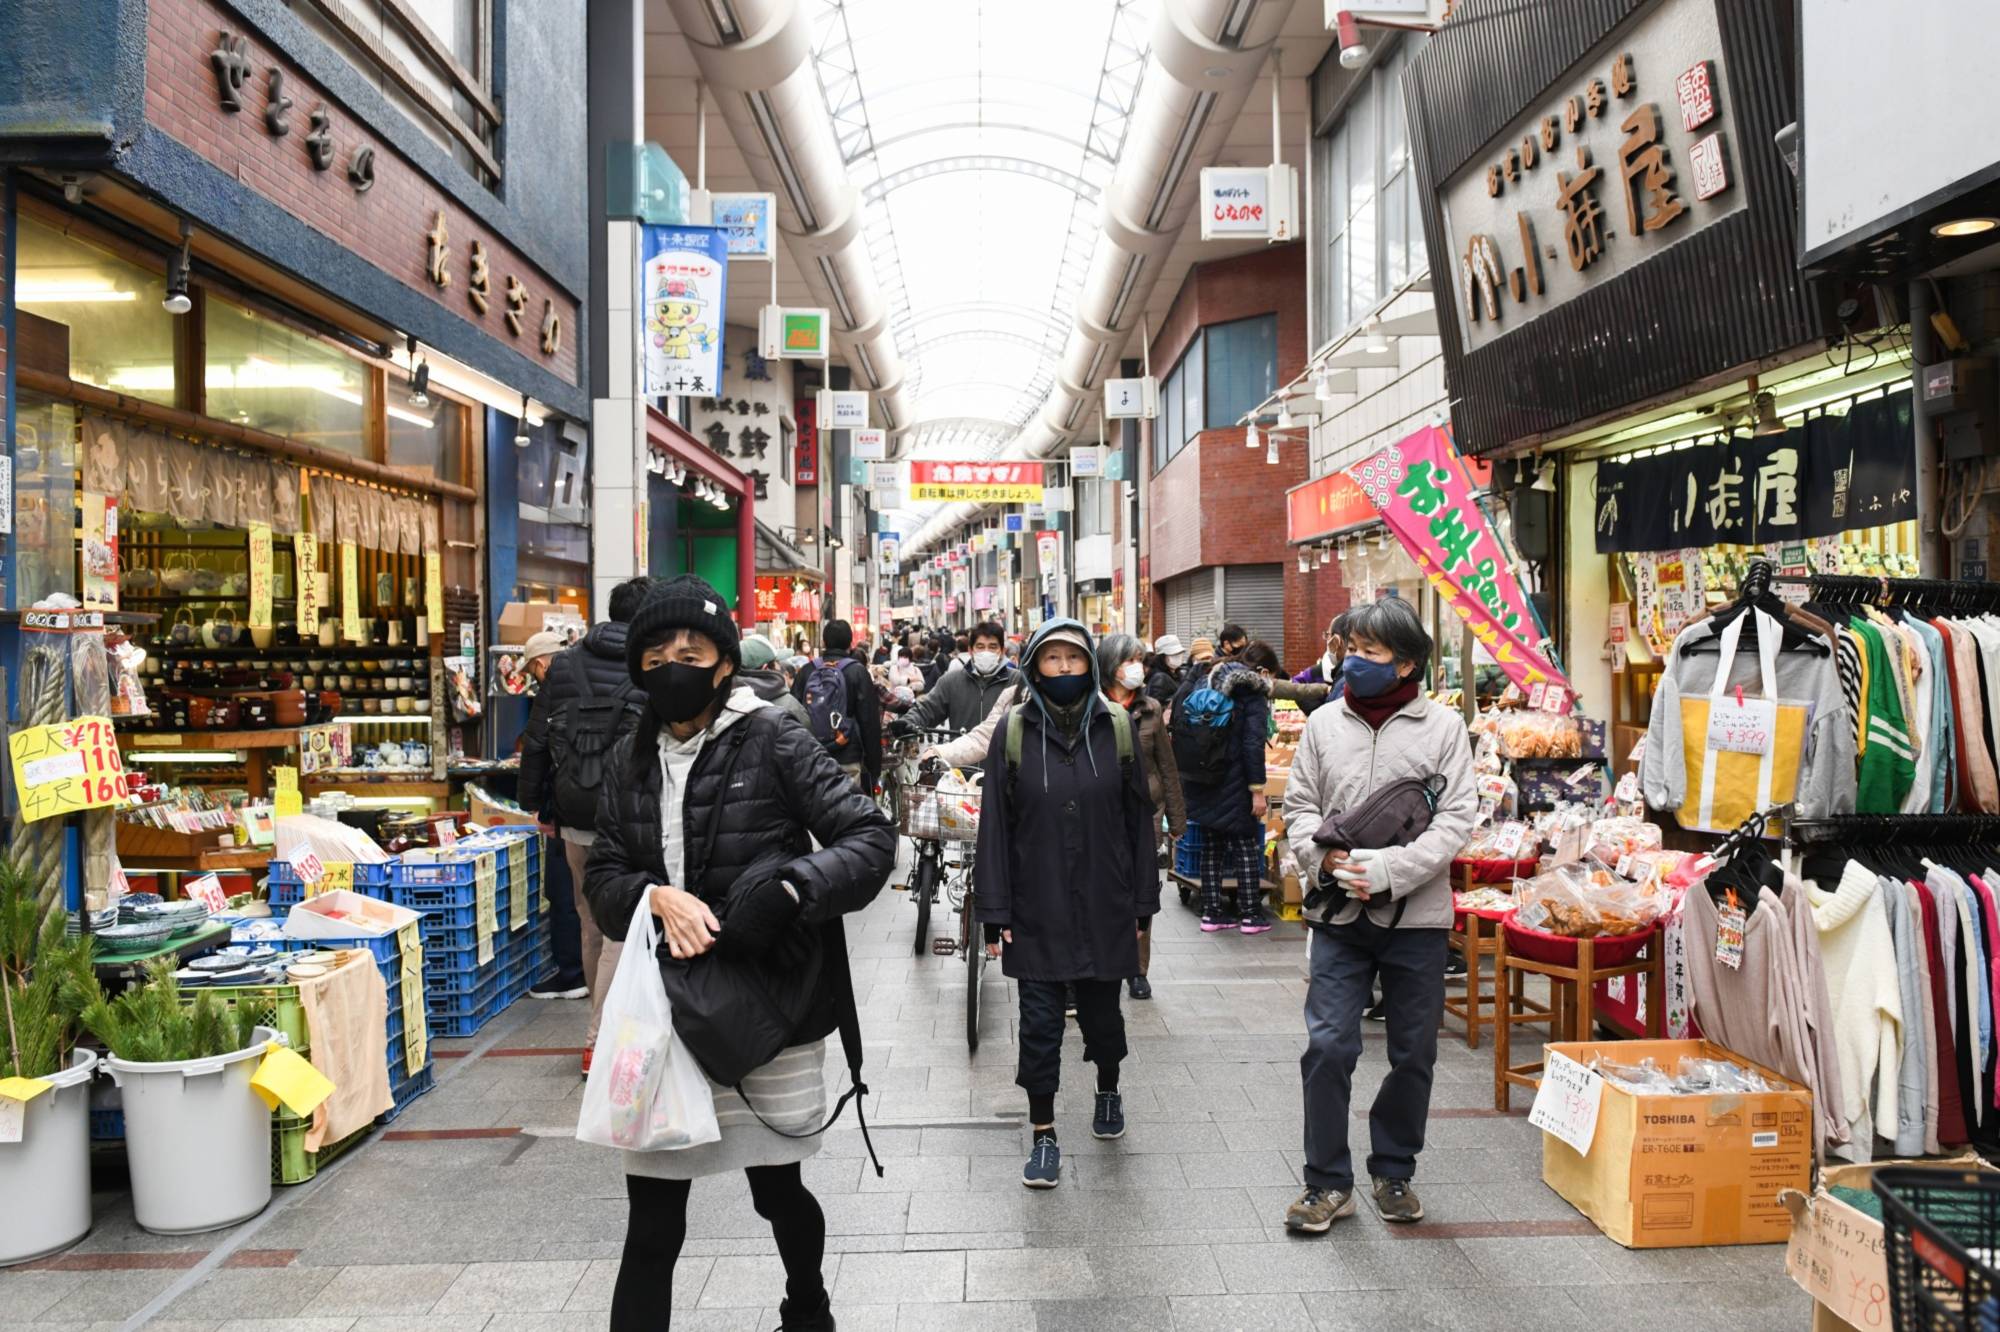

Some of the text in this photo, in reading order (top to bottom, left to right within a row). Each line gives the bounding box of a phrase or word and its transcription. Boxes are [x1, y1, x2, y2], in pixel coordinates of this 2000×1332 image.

[1692, 63, 1713, 122] おかき
[211, 29, 375, 192] せともの
[1215, 204, 1263, 221] しなのや
[700, 397, 771, 418] 株式会社
[919, 487, 1035, 499] 自転車は押して歩きましょう。
[1963, 565, 1983, 577] 5-10
[64, 721, 115, 748] ¥75
[1727, 730, 1766, 746] ¥399
[80, 746, 121, 774] 110
[82, 775, 128, 804] 160
[292, 853, 323, 880] ¥150
[1675, 936, 1684, 1003] お年賀
[1643, 1114, 1696, 1125] TOSHIBA
[1642, 1145, 1682, 1153] ER-T60E
[1644, 1174, 1695, 1186] 石窯オーブン
